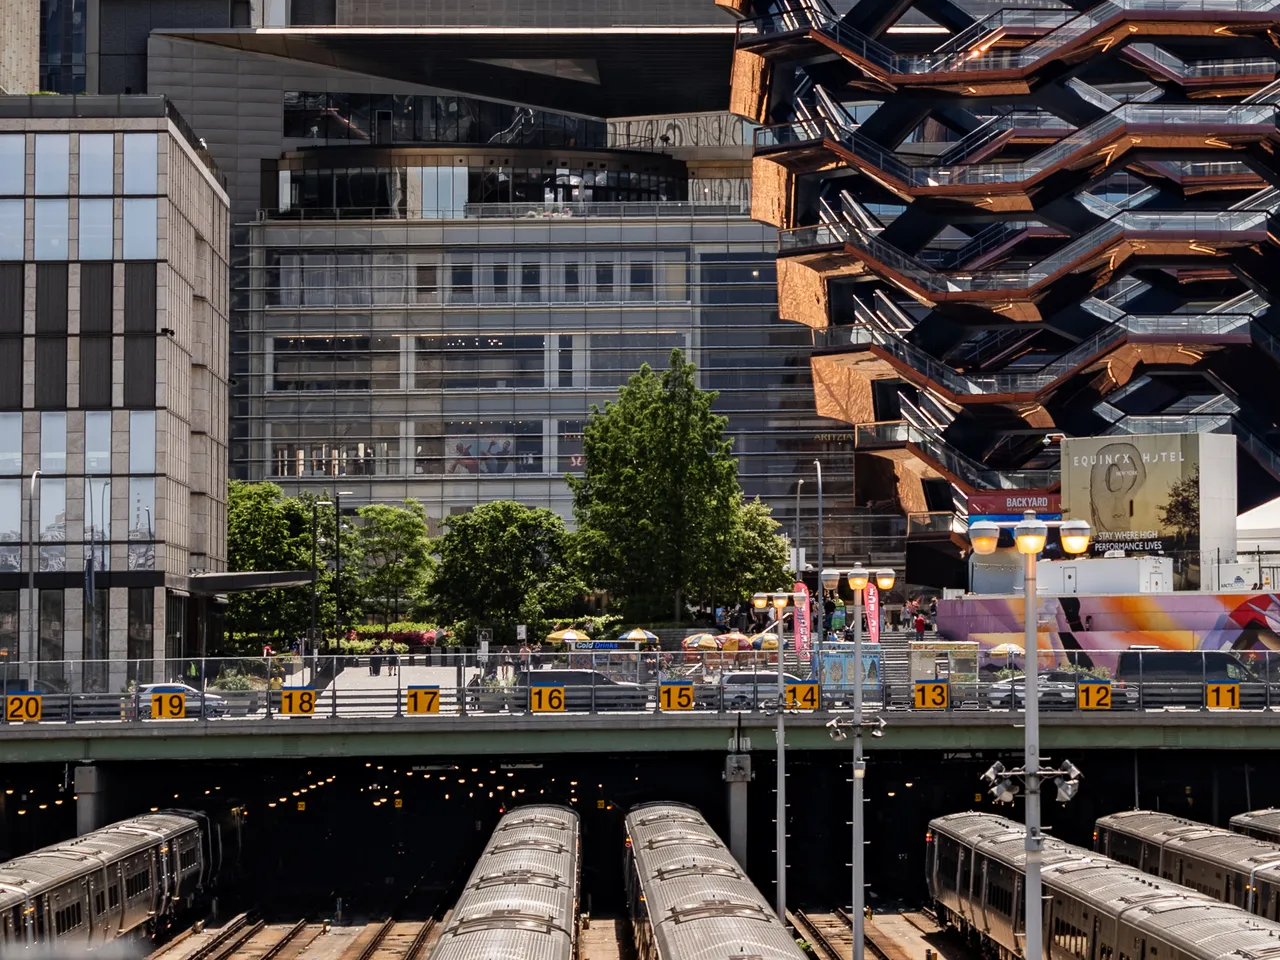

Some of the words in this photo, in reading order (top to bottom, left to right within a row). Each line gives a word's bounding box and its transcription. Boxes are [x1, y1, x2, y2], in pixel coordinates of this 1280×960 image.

[813, 433, 853, 441] ARITZIA
[1006, 497, 1048, 507] BACKYARD
[1098, 531, 1113, 541] STAY
[1114, 530, 1138, 541] WHERE
[1139, 530, 1158, 539] HIGH
[1094, 541, 1143, 552] PERFORMANCE
[1144, 541, 1162, 550] LIVES
[284, 692, 312, 713] 18
[410, 692, 437, 711] 17
[534, 689, 562, 709] 16
[663, 688, 690, 707] 15
[788, 687, 817, 707] 14
[917, 685, 945, 705] 13
[1082, 687, 1110, 706] 12
[1212, 687, 1235, 706] 11
[10, 697, 38, 718] 20
[154, 695, 182, 716] 19
